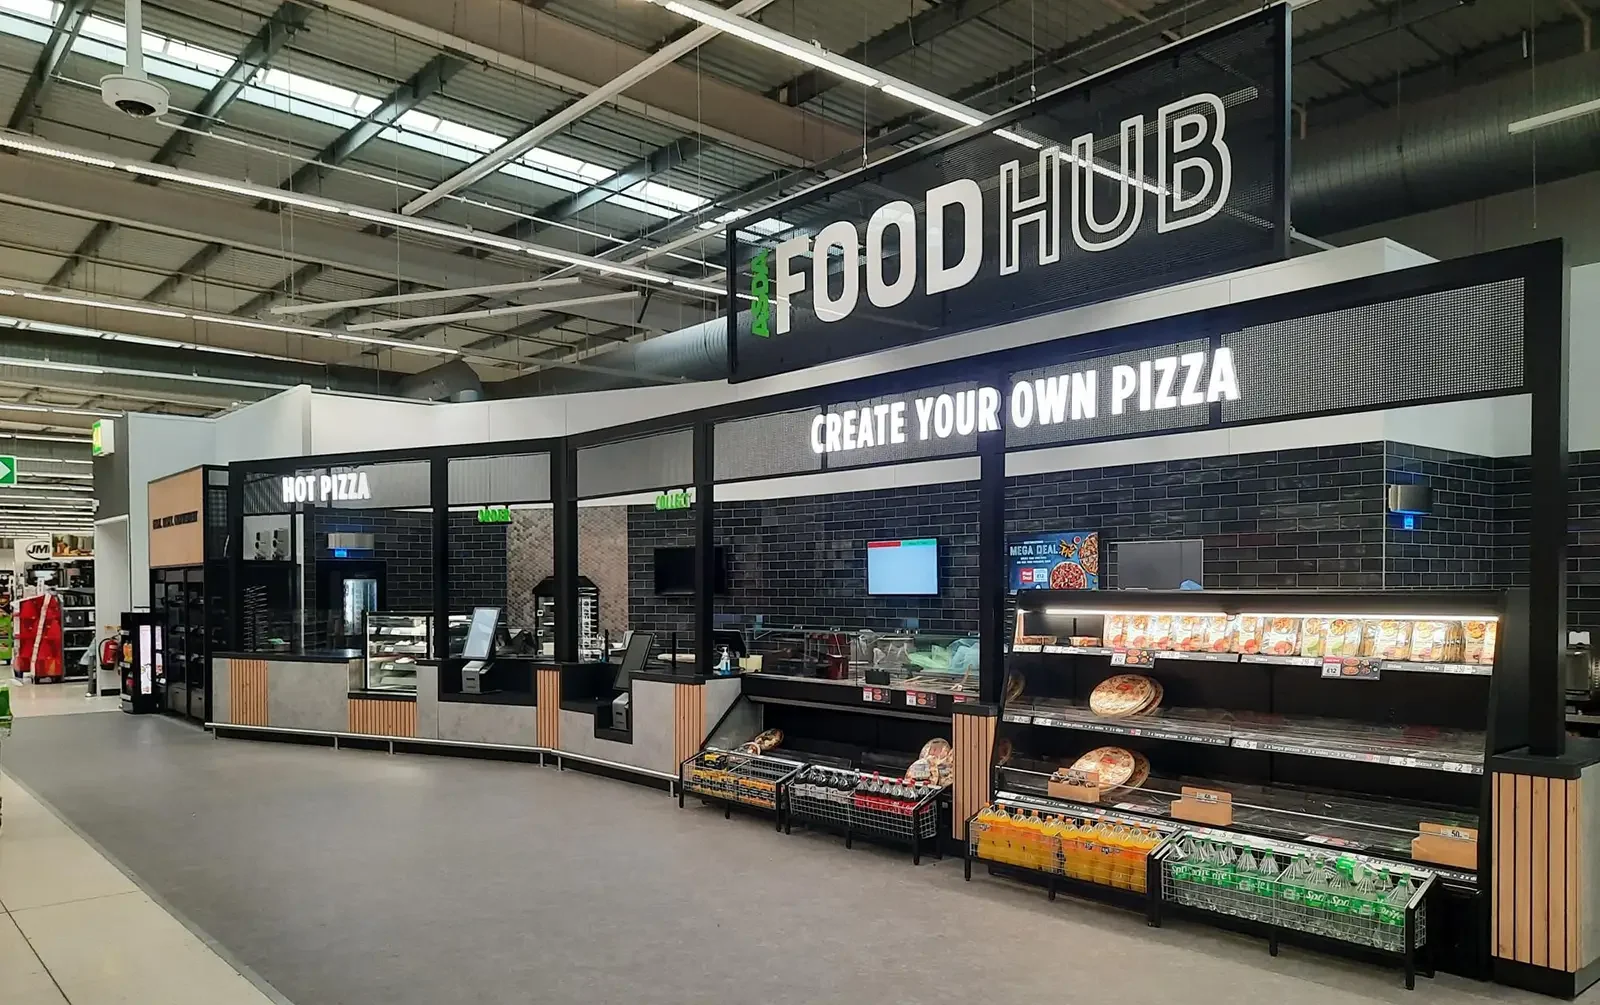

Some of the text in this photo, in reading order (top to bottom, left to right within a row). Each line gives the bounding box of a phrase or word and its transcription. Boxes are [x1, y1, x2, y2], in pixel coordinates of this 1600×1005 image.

[775, 93, 1232, 336] FOOD HUB
[751, 247, 769, 338] ASDA
[810, 347, 1240, 454] CREATE YOUR OWN PIZZA
[281, 472, 371, 503] HOT PIZZA
[28, 545, 50, 554] JM
[1010, 544, 1058, 556] MEGA DEAL
